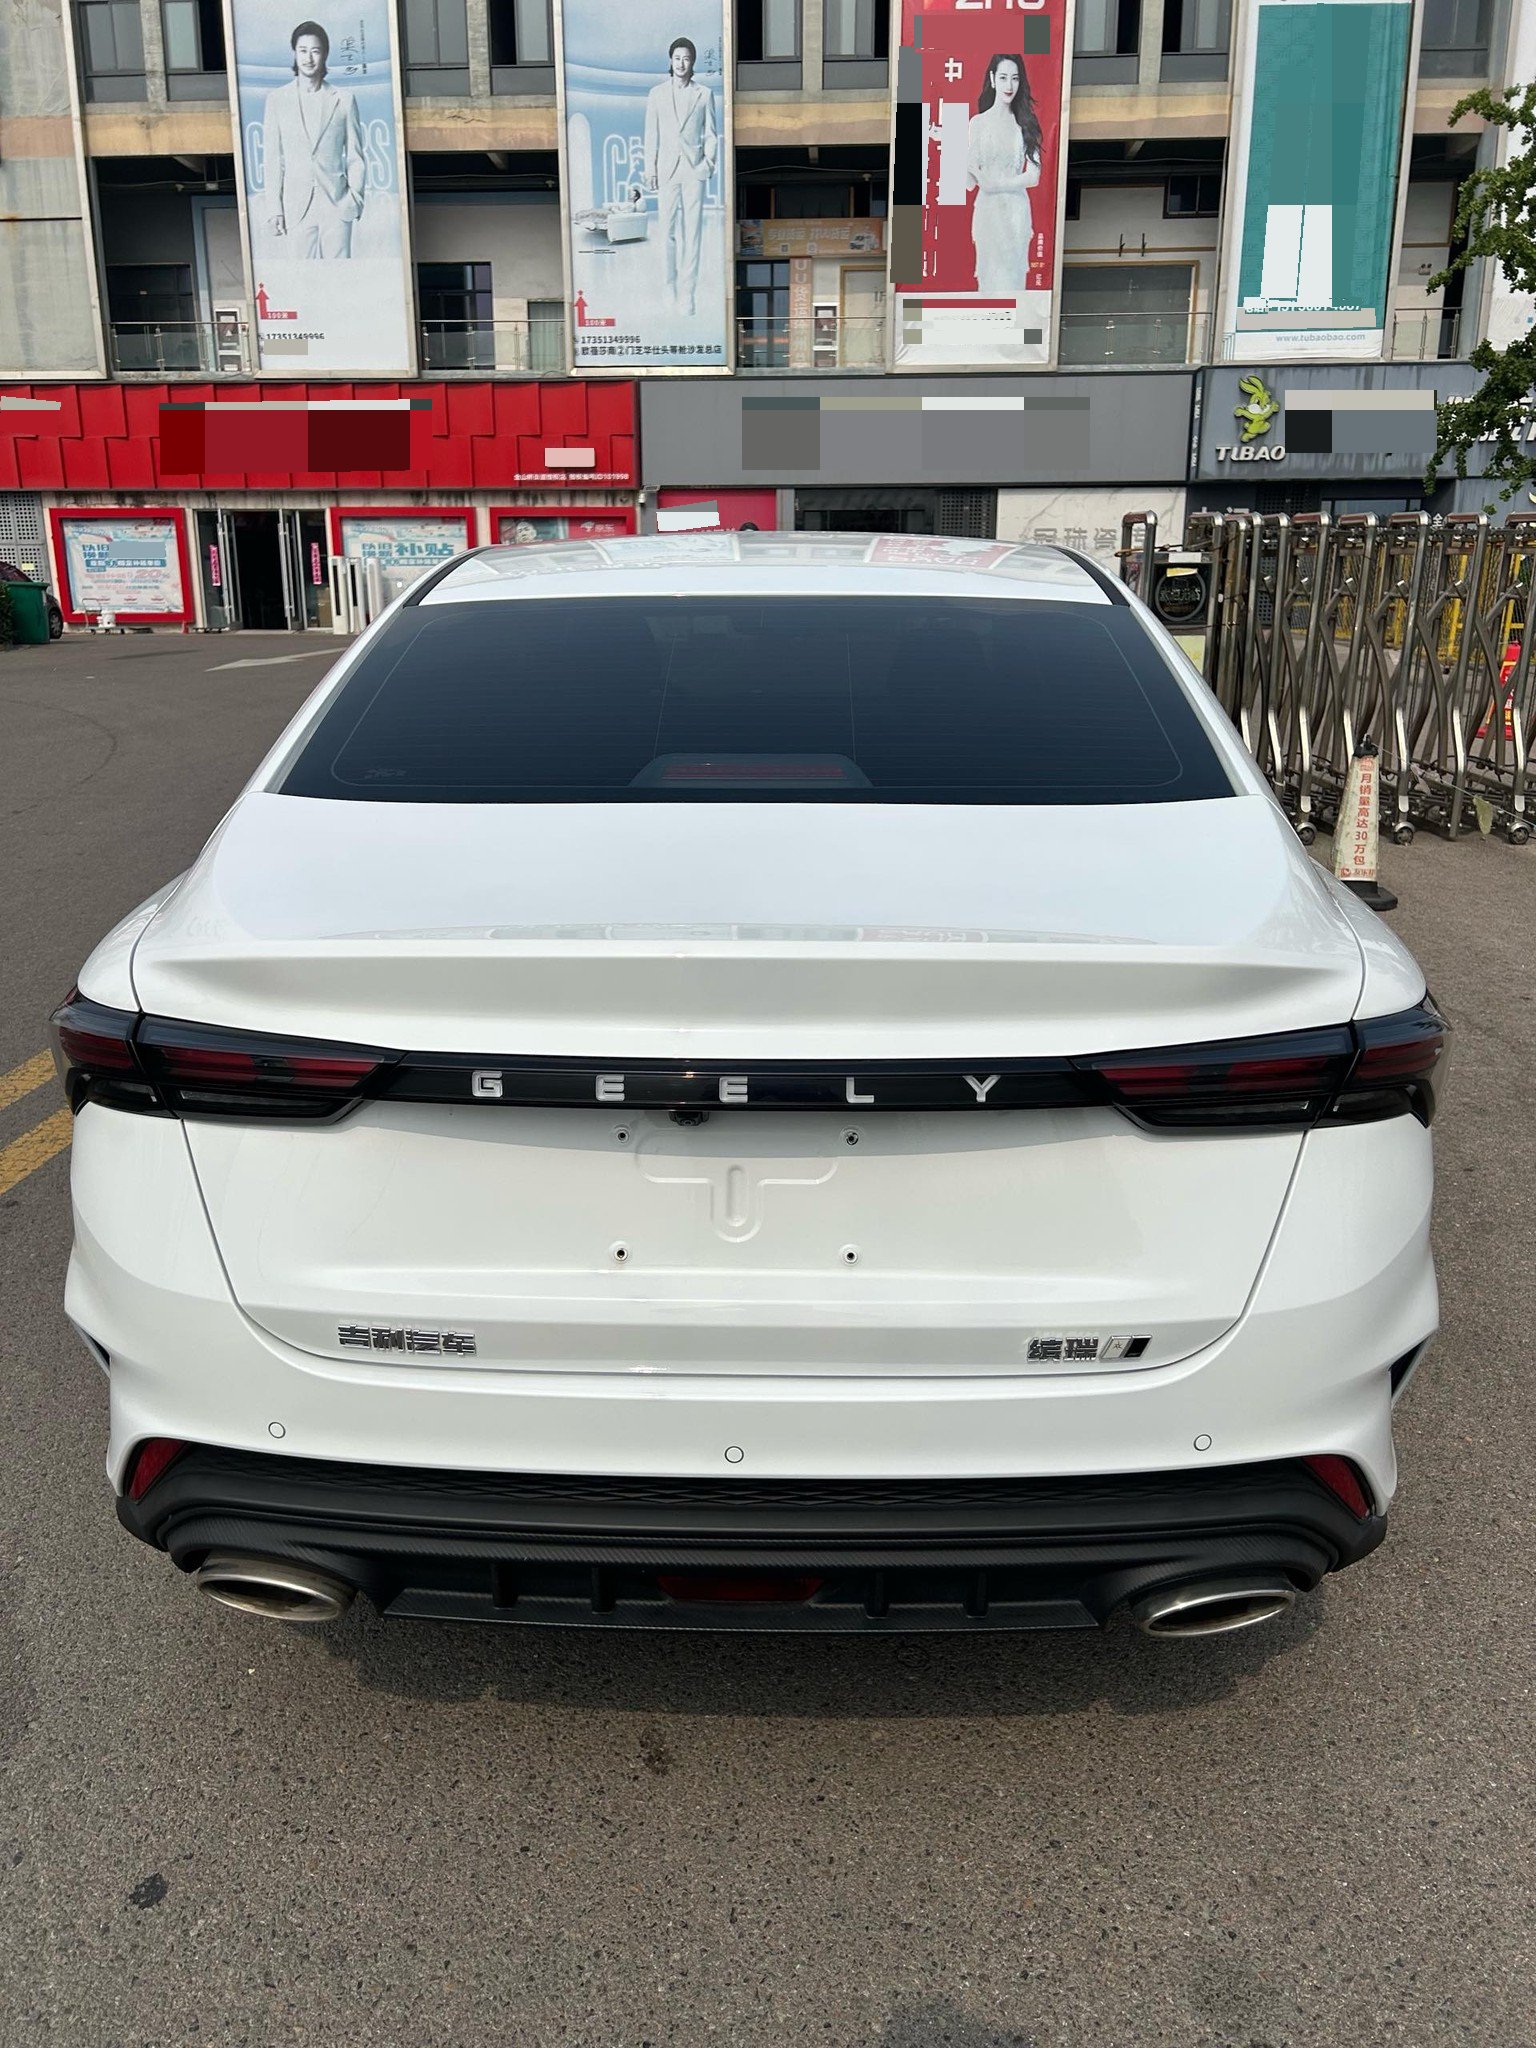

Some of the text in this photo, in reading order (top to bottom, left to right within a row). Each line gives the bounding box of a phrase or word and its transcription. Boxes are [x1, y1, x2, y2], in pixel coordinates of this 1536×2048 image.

[581, 335, 641, 344] 17351349996
[1275, 333, 1366, 343] www.tubaobao.com
[394, 542, 455, 557] 补贴
[470, 1069, 1001, 1104] GEELY
[337, 1323, 477, 1356] 吉利汽车
[1026, 1336, 1100, 1363] 缤瑞
